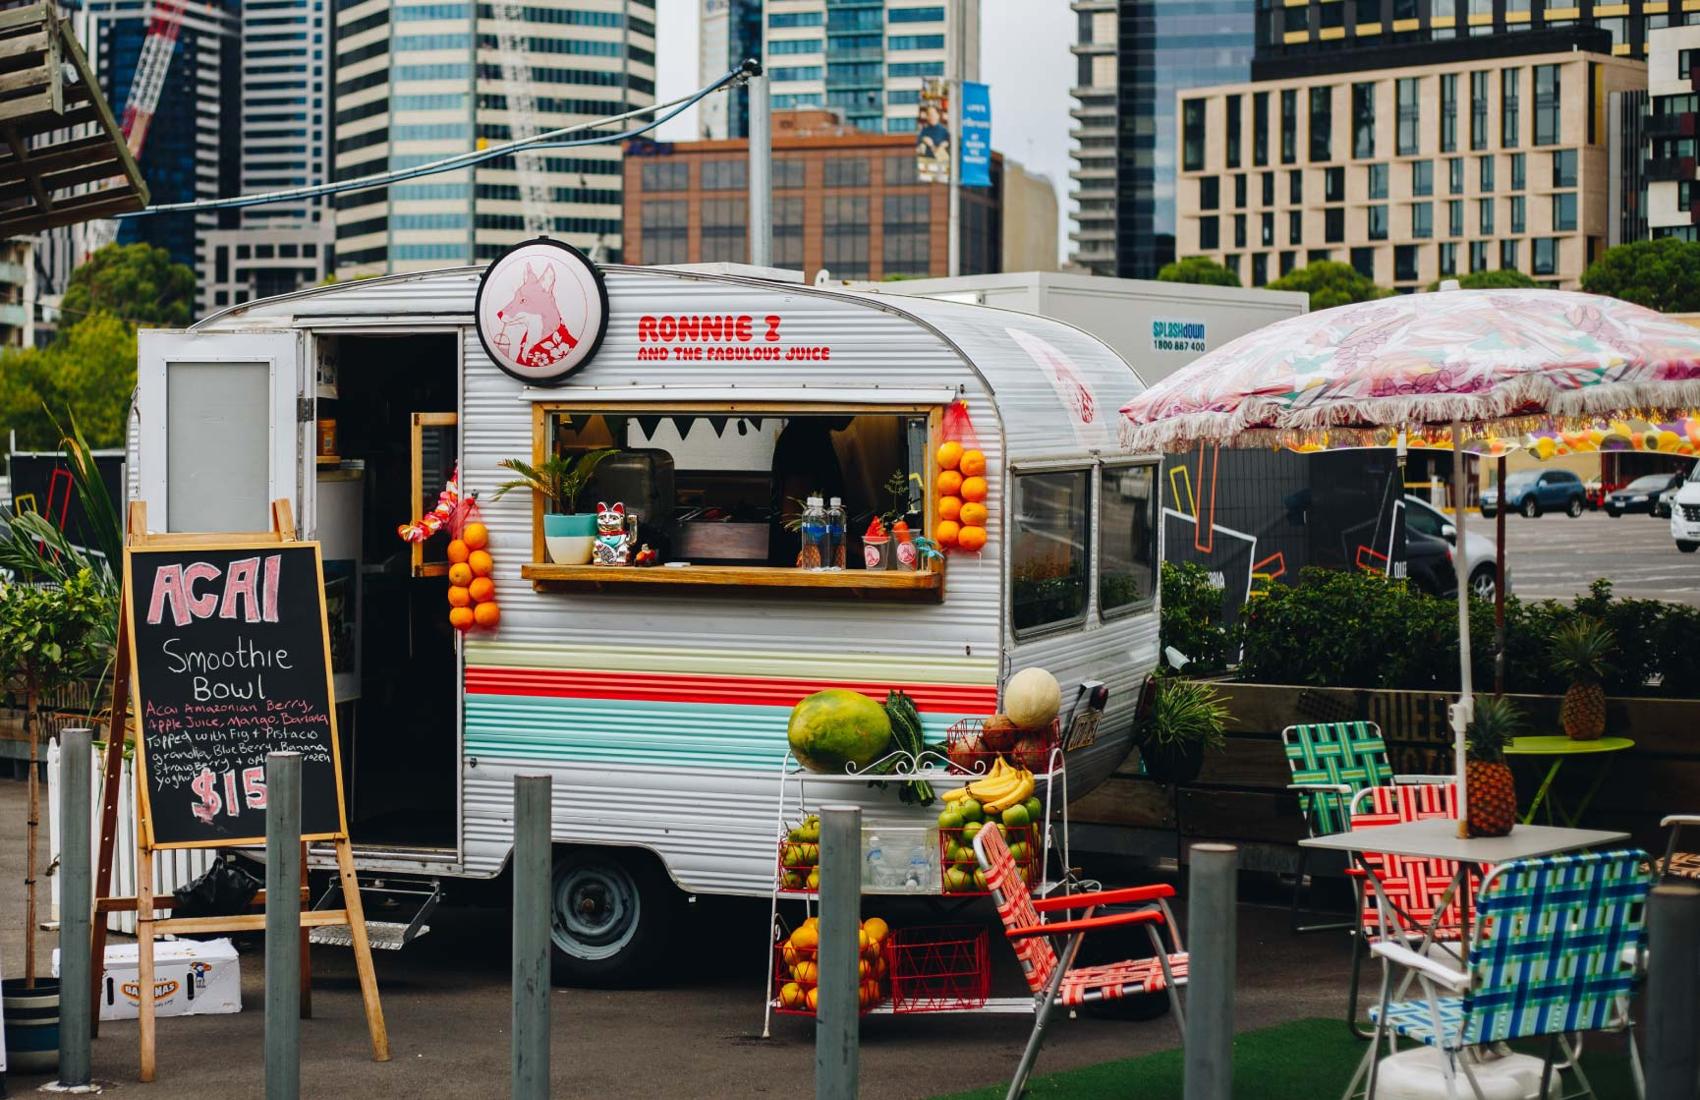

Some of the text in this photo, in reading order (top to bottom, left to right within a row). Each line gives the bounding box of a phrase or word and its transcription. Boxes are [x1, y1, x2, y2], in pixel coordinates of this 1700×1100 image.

[638, 314, 753, 342] RONNIE
[637, 347, 831, 361] AND THE FABULOUS JUICE
[1154, 340, 1173, 350] 1800
[1190, 342, 1206, 352] 400
[146, 554, 282, 627] ACAI
[162, 635, 294, 674] Smoothie
[193, 674, 266, 702] Bowl
[146, 700, 178, 718] Acai
[184, 703, 258, 714] Amazonian
[146, 730, 193, 750] Topped
[194, 731, 227, 743] with
[230, 728, 250, 743] Fig
[125, 983, 175, 998] BANAS
